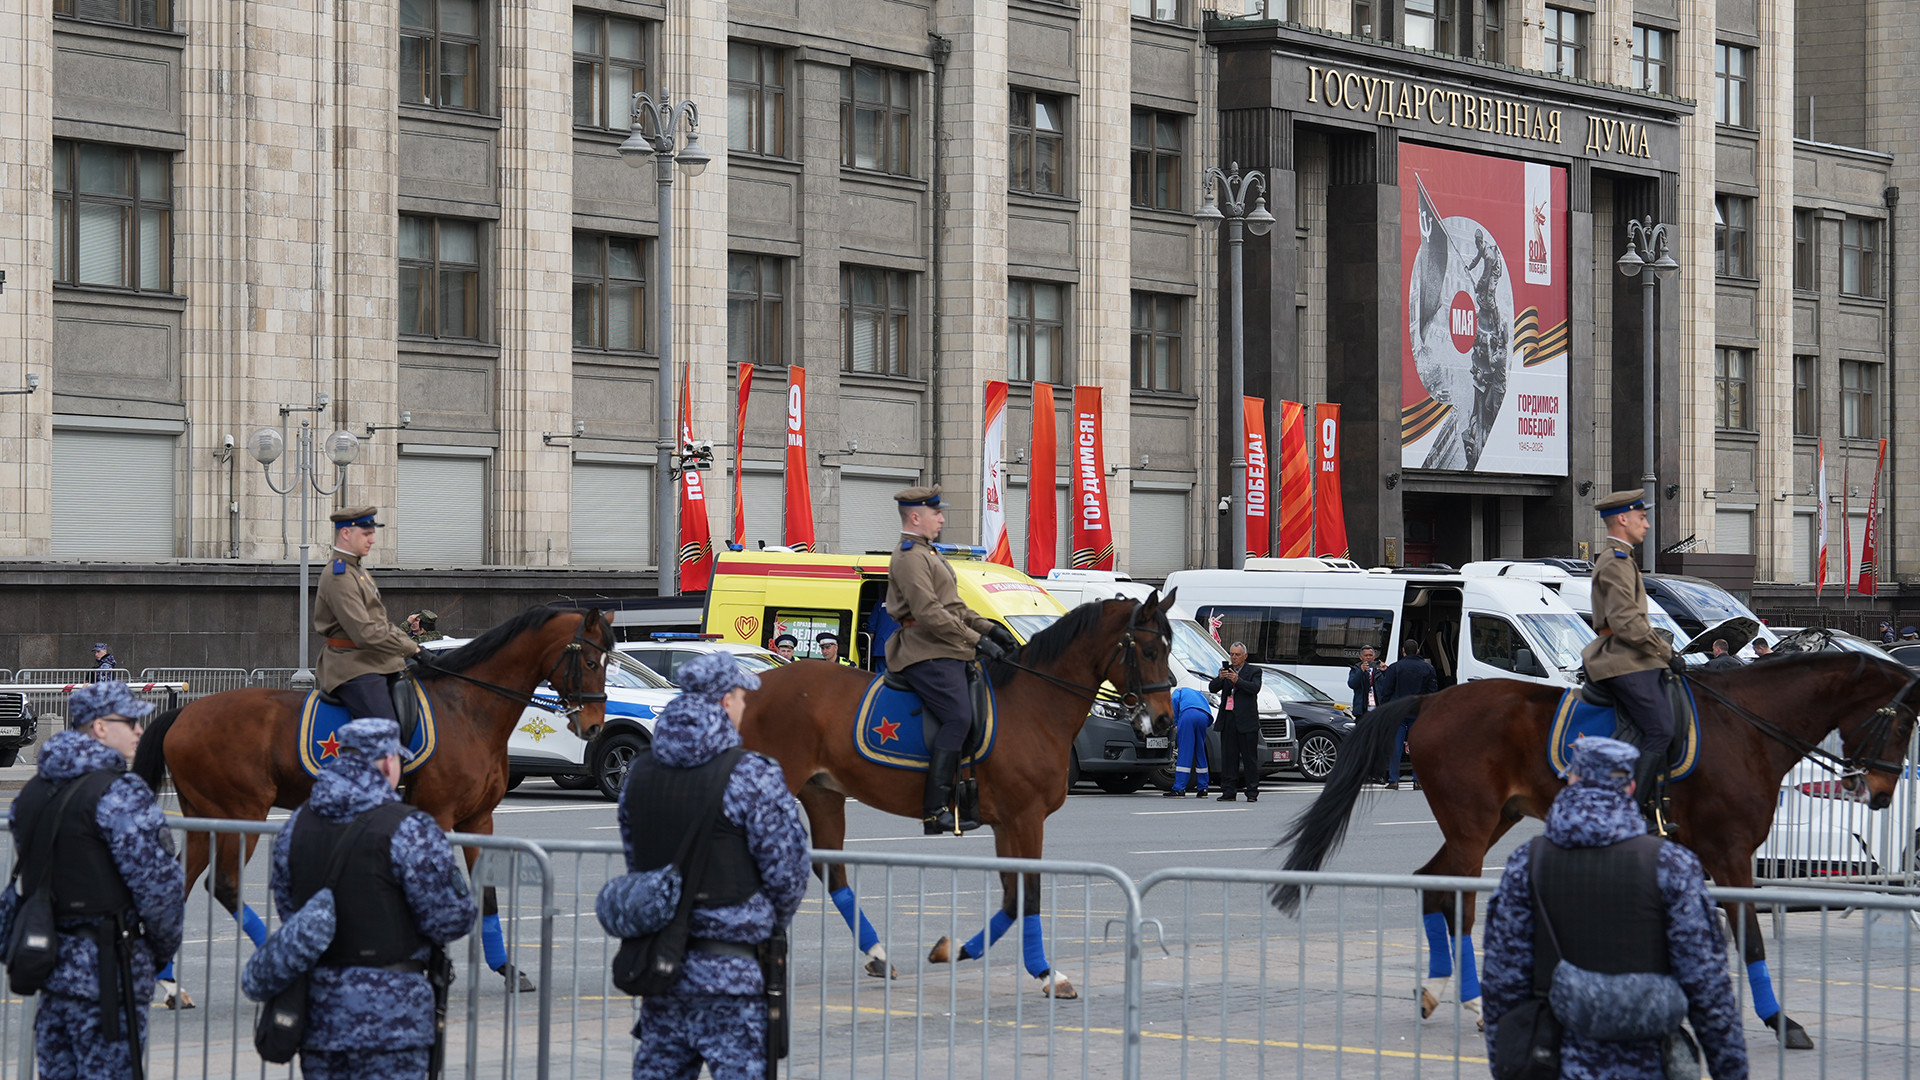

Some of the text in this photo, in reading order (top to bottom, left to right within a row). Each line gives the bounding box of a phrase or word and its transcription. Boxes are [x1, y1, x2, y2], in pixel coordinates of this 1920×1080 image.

[1308, 66, 1651, 159] ГОСУДАРСТВЕННАЯ ДУМА
[1529, 240, 1539, 260] 80
[1528, 263, 1548, 275] ПОБЕДА!
[1452, 308, 1474, 336] МАЯ
[789, 384, 802, 431] 9
[1518, 394, 1559, 415] ГОРДИМСЯ
[1322, 418, 1336, 459] 9
[1518, 417, 1556, 439] ПОБЕДОЙ!
[1079, 413, 1103, 530] ГОРДИМСЯ!
[1247, 433, 1266, 517] ПОБЕДА!
[794, 641, 822, 654] ОБЕД
